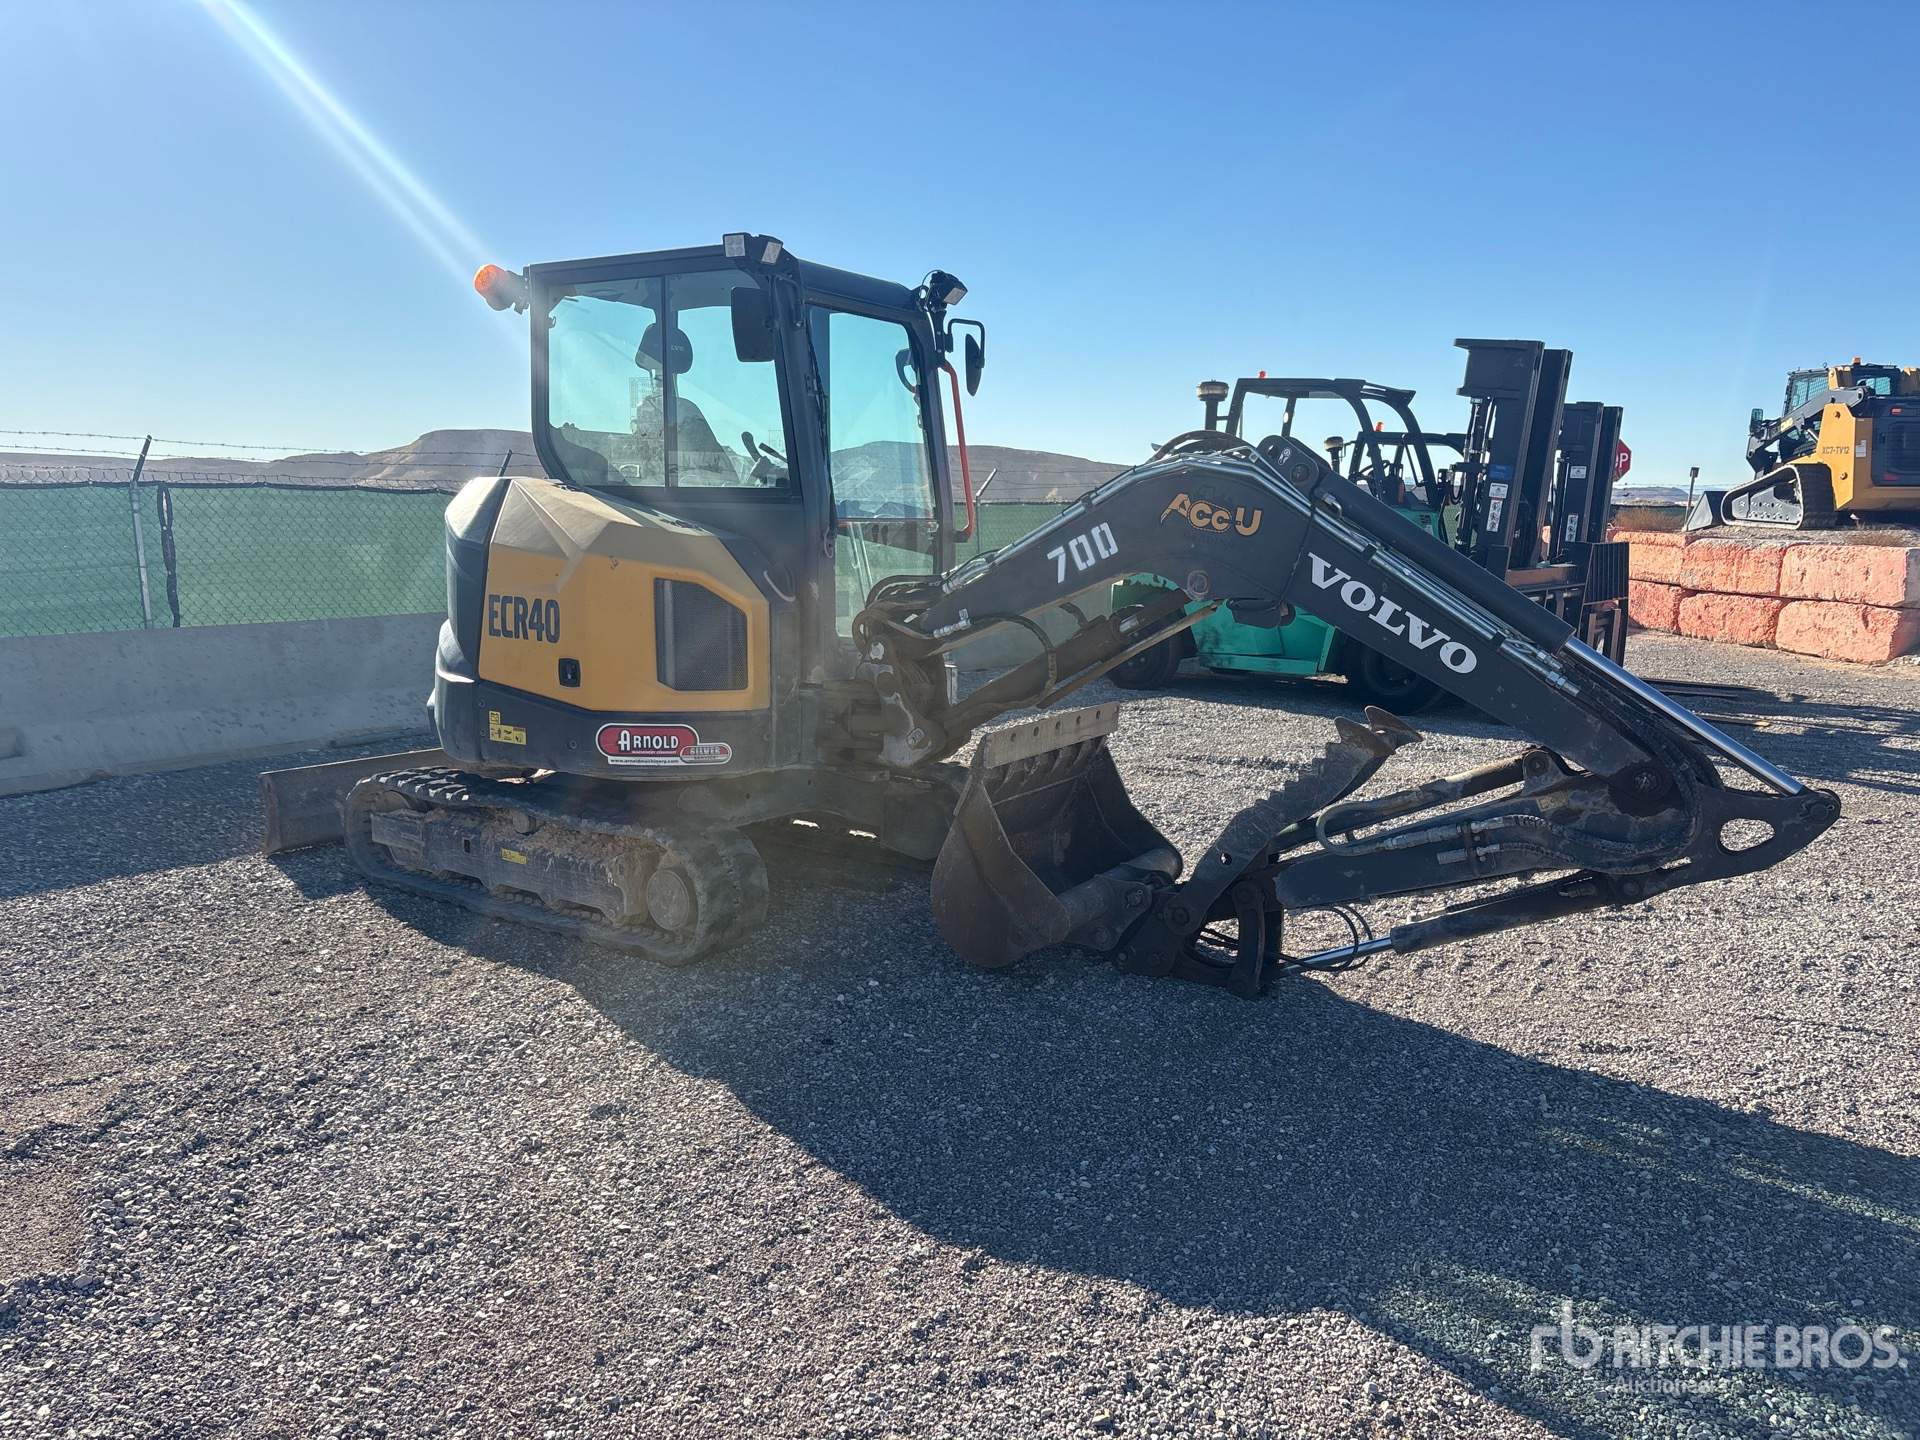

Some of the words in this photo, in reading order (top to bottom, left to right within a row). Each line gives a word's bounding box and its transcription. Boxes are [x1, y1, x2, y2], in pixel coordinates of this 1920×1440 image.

[1821, 446, 1850, 455] XC7-TV12
[1047, 522, 1119, 584] 700
[488, 594, 560, 643] ECR40
[1307, 552, 1477, 674] VOLVO
[618, 729, 679, 751] ARNOLD
[689, 747, 721, 755] SILVER
